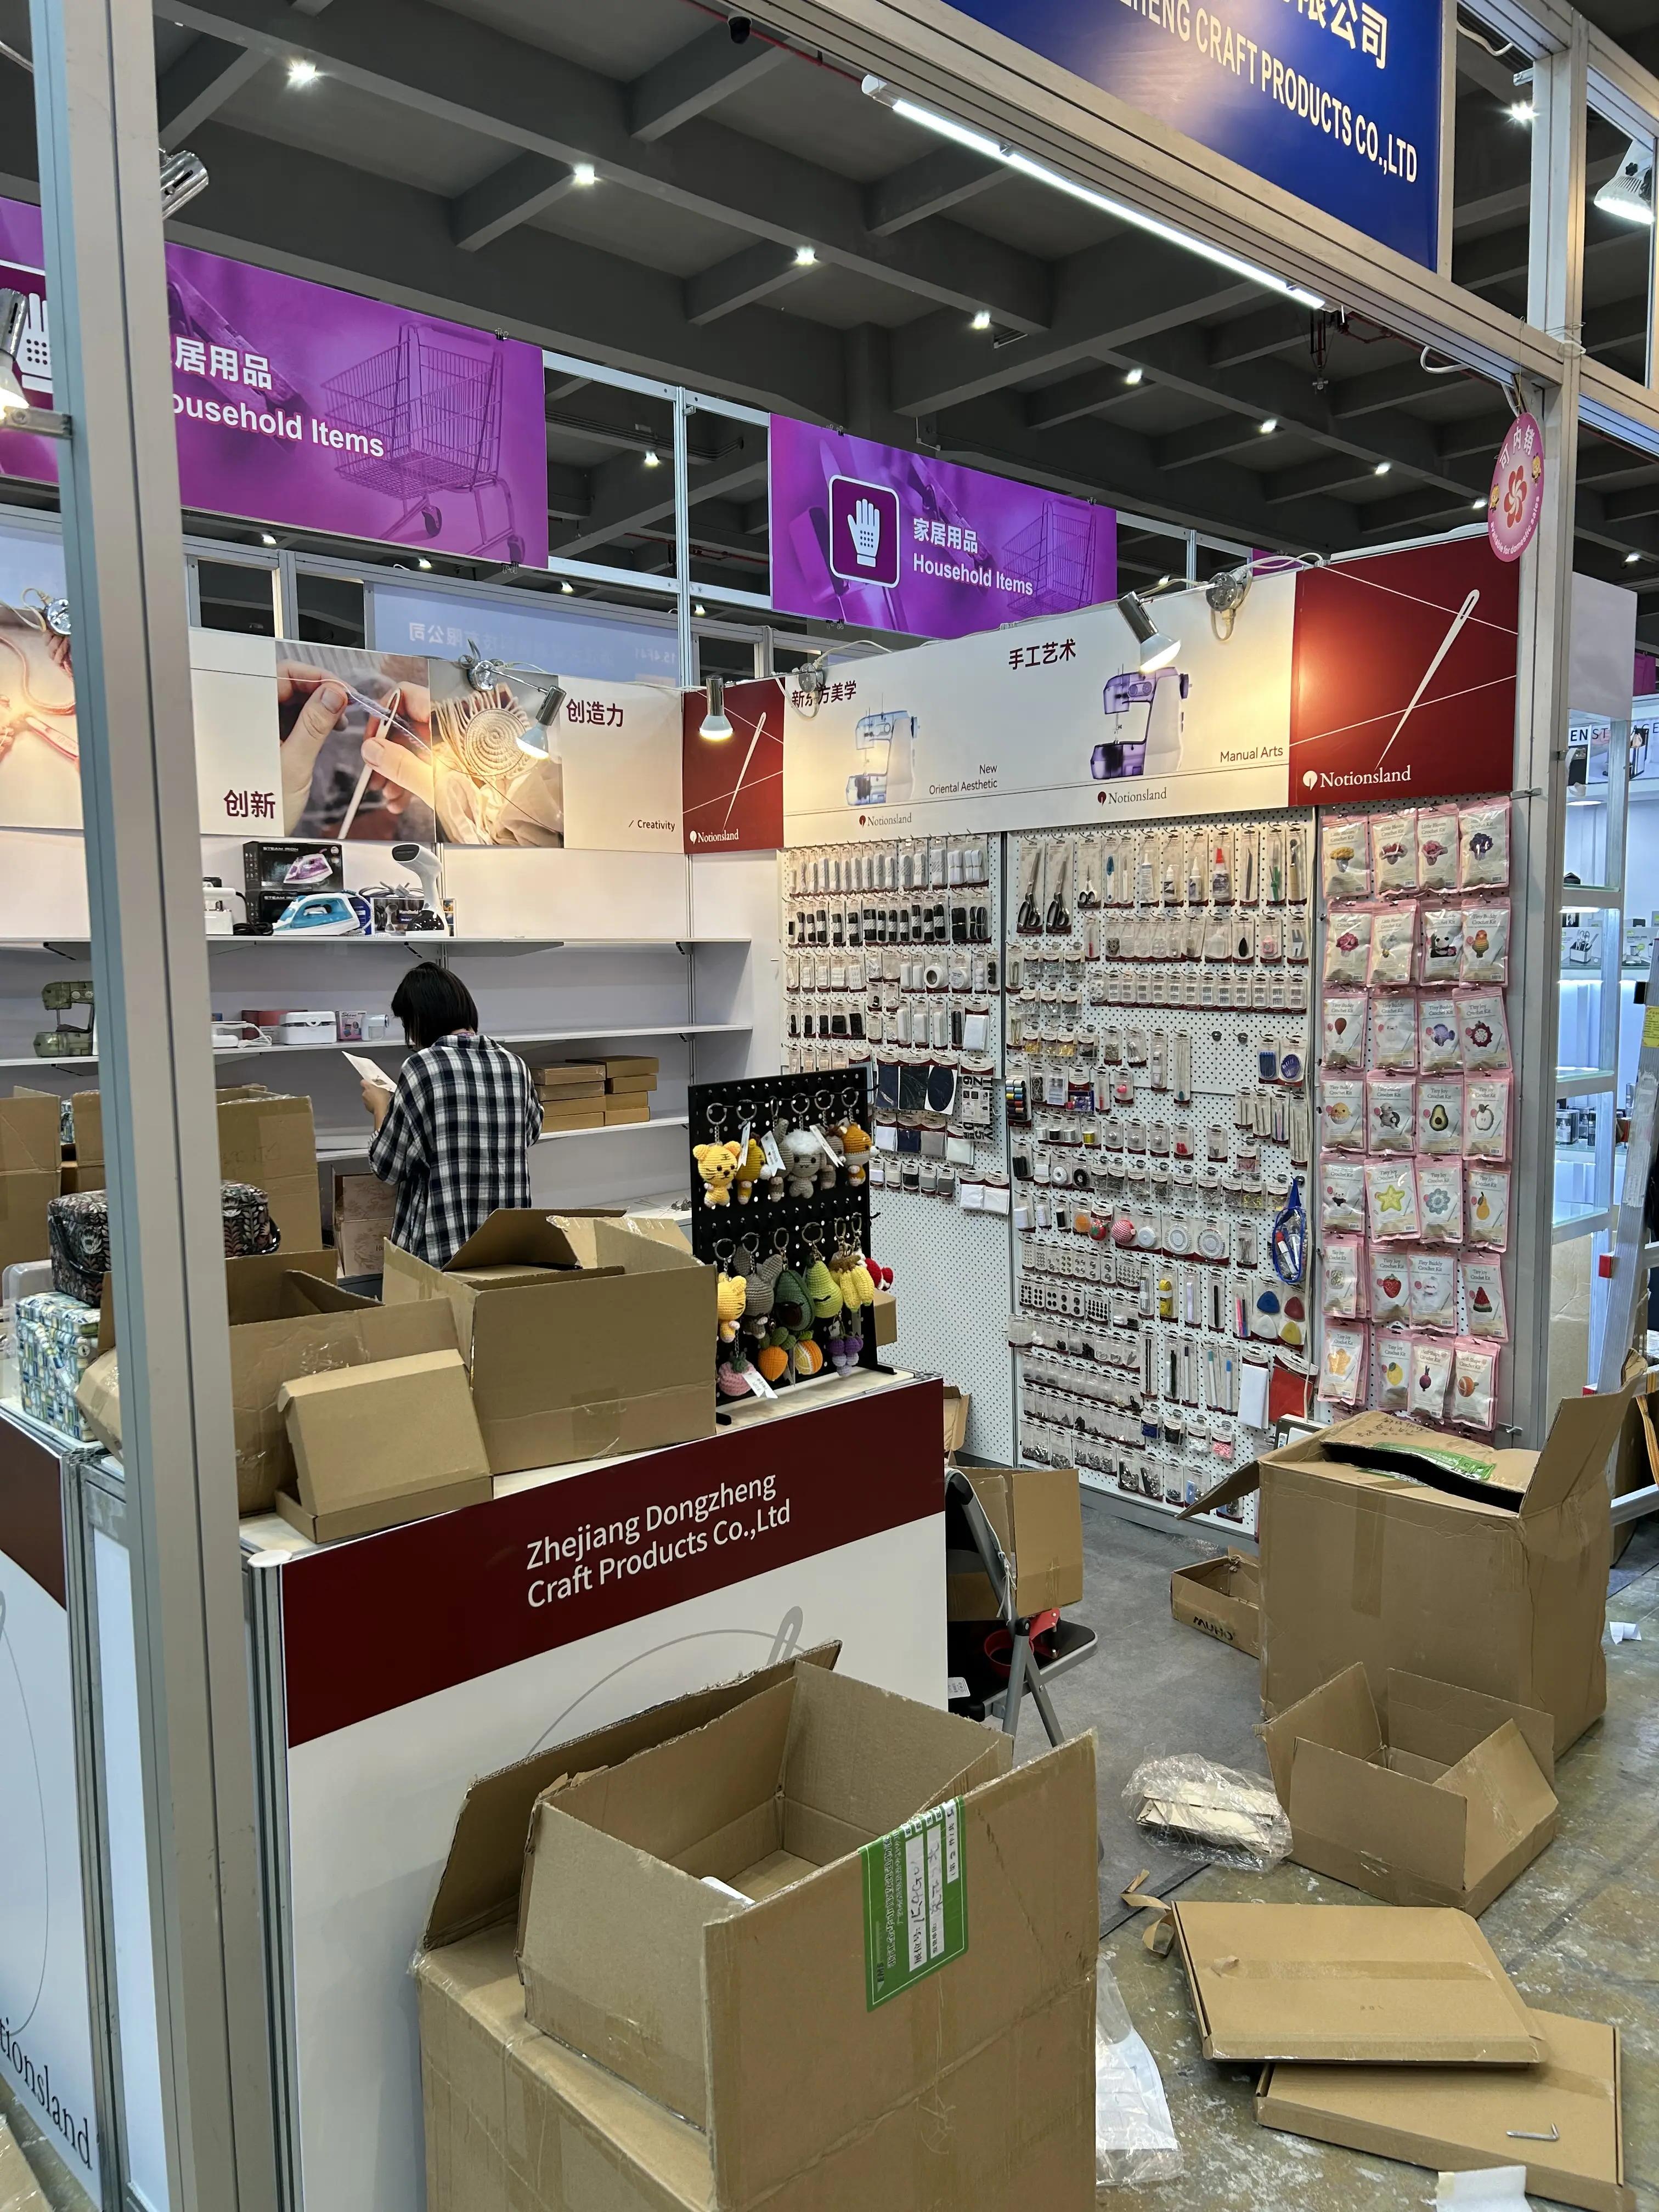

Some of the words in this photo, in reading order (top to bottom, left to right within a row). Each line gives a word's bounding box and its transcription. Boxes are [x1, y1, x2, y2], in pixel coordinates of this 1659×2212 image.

[1196, 8, 1257, 84] CRAFT
[1262, 50, 1352, 146] PRODUCTS
[1356, 114, 1417, 183] CO.,LTD
[312, 419, 385, 457] Items
[913, 518, 979, 554] 家居用品
[1490, 521, 1504, 552] available
[1510, 525, 1532, 554] domestic
[1531, 496, 1539, 525] sales
[913, 552, 992, 587] Household
[996, 571, 1034, 595] Items
[1008, 639, 1076, 670] 手工艺术
[566, 698, 624, 727] 创造力
[1220, 747, 1259, 763] Manual
[1261, 745, 1283, 760] Arts
[979, 764, 997, 774] New
[1320, 765, 1412, 788] Notionsland
[929, 782, 959, 795] Oriental
[961, 778, 997, 791] Aesthetic
[1108, 787, 1167, 805] Notionsland
[223, 790, 275, 819] 创新
[867, 812, 912, 826] Notionsland
[637, 819, 675, 832] Creativity
[697, 828, 740, 843] Notionsland
[527, 1516, 640, 1570] Zhejiang
[646, 1474, 777, 1532] Dongzheng
[528, 1565, 592, 1607] Craft
[600, 1531, 708, 1585] Products
[713, 1499, 791, 1545] Co.,Ltd
